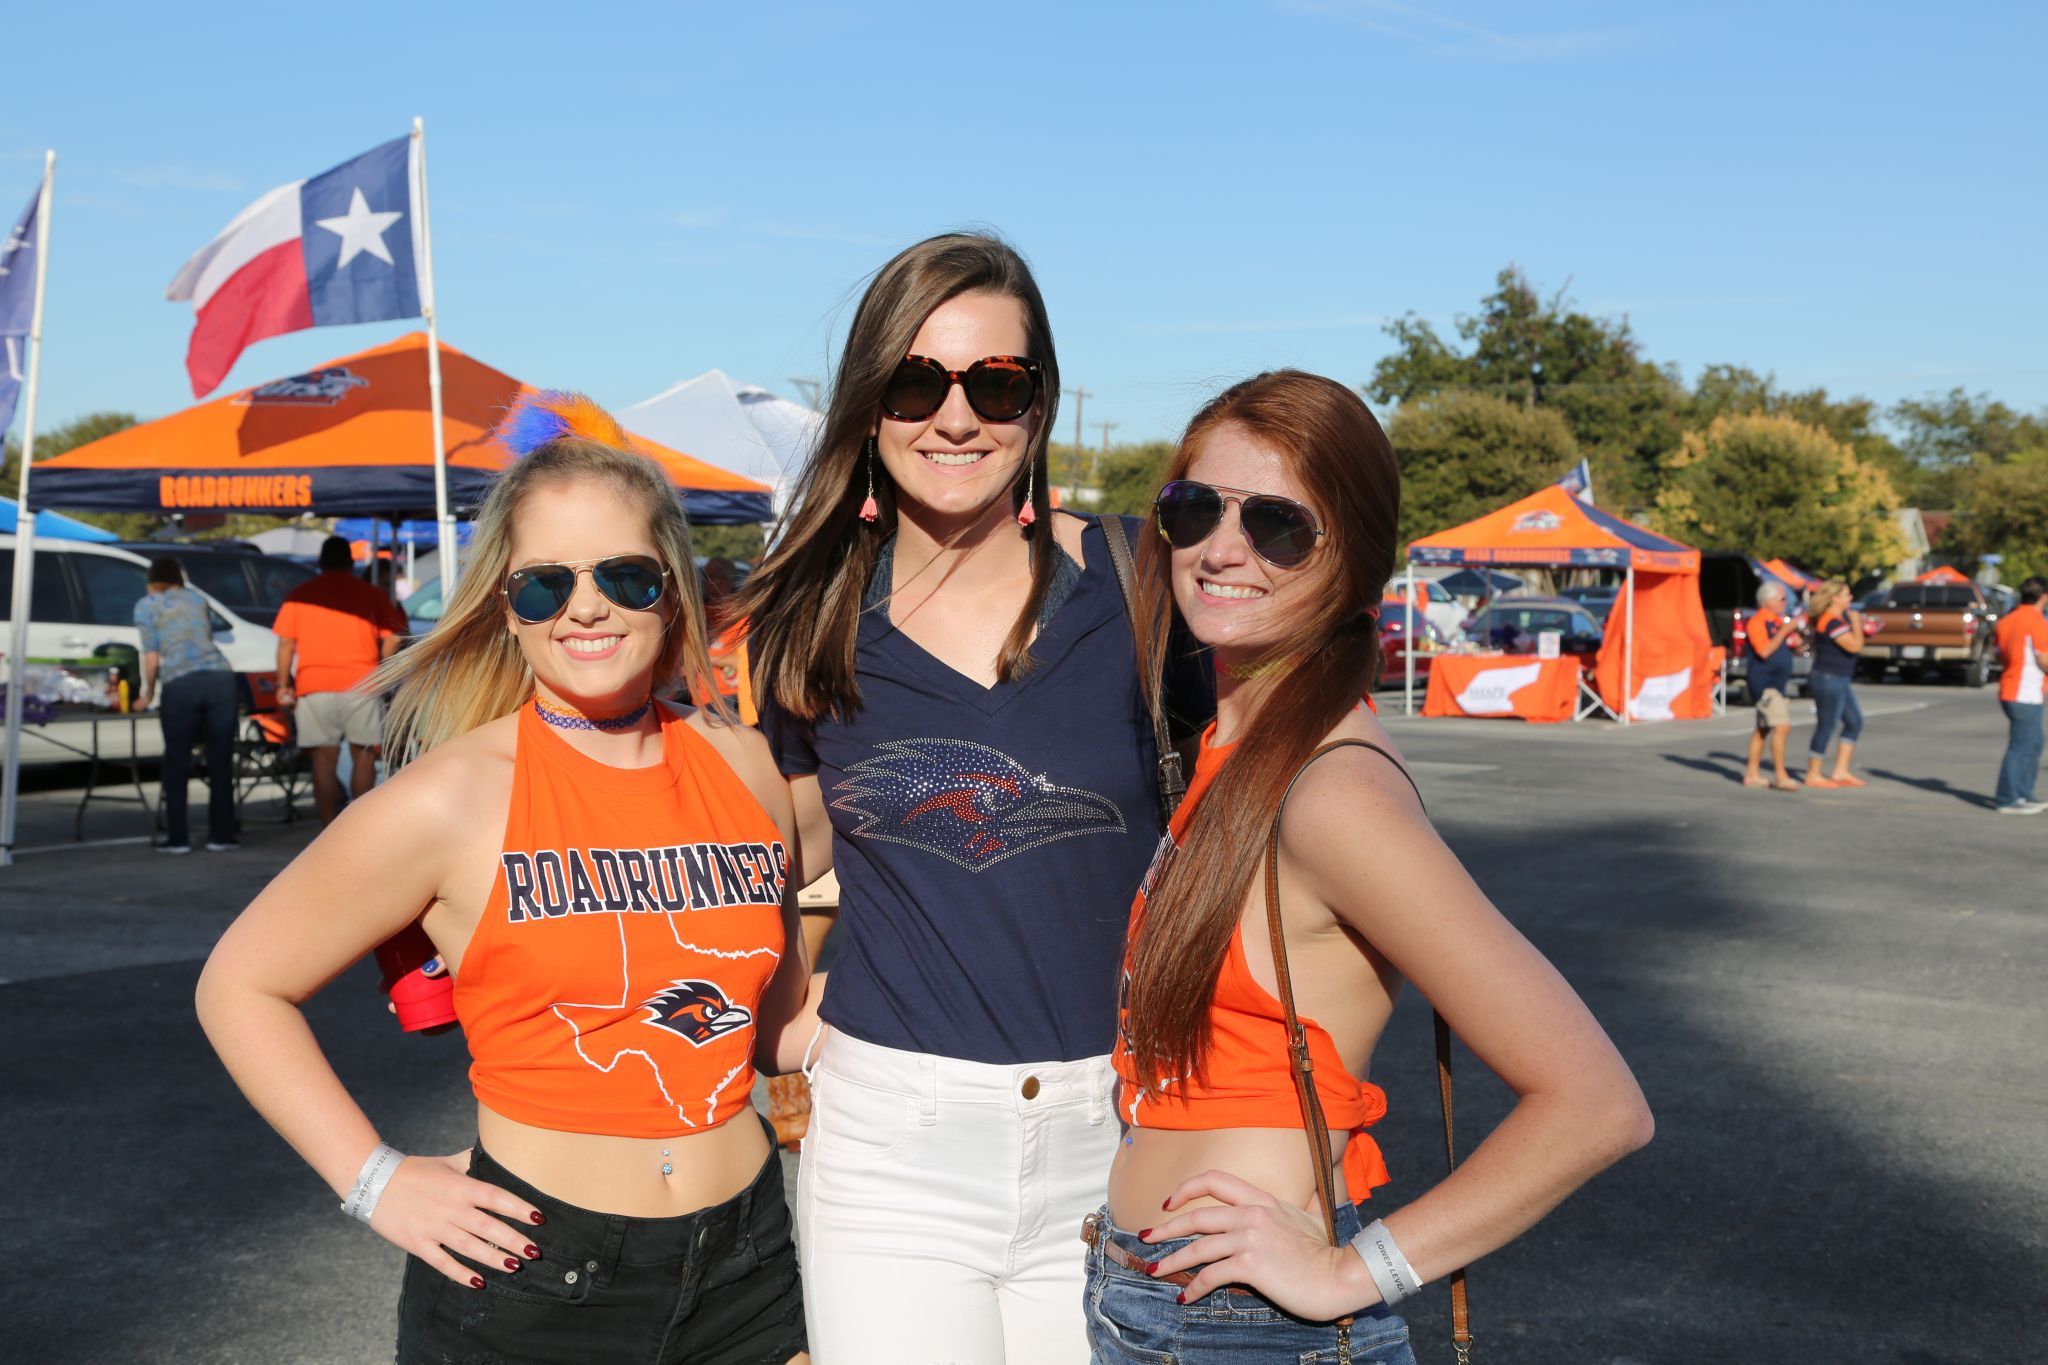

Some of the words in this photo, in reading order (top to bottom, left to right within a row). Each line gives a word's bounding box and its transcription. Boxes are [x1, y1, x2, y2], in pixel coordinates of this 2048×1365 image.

[160, 474, 312, 507] ROADRUNNERS
[501, 841, 787, 923] ROADRUNNERS
[1375, 1240, 1393, 1267] LOWER
[1389, 1269, 1405, 1292] LEVEL
